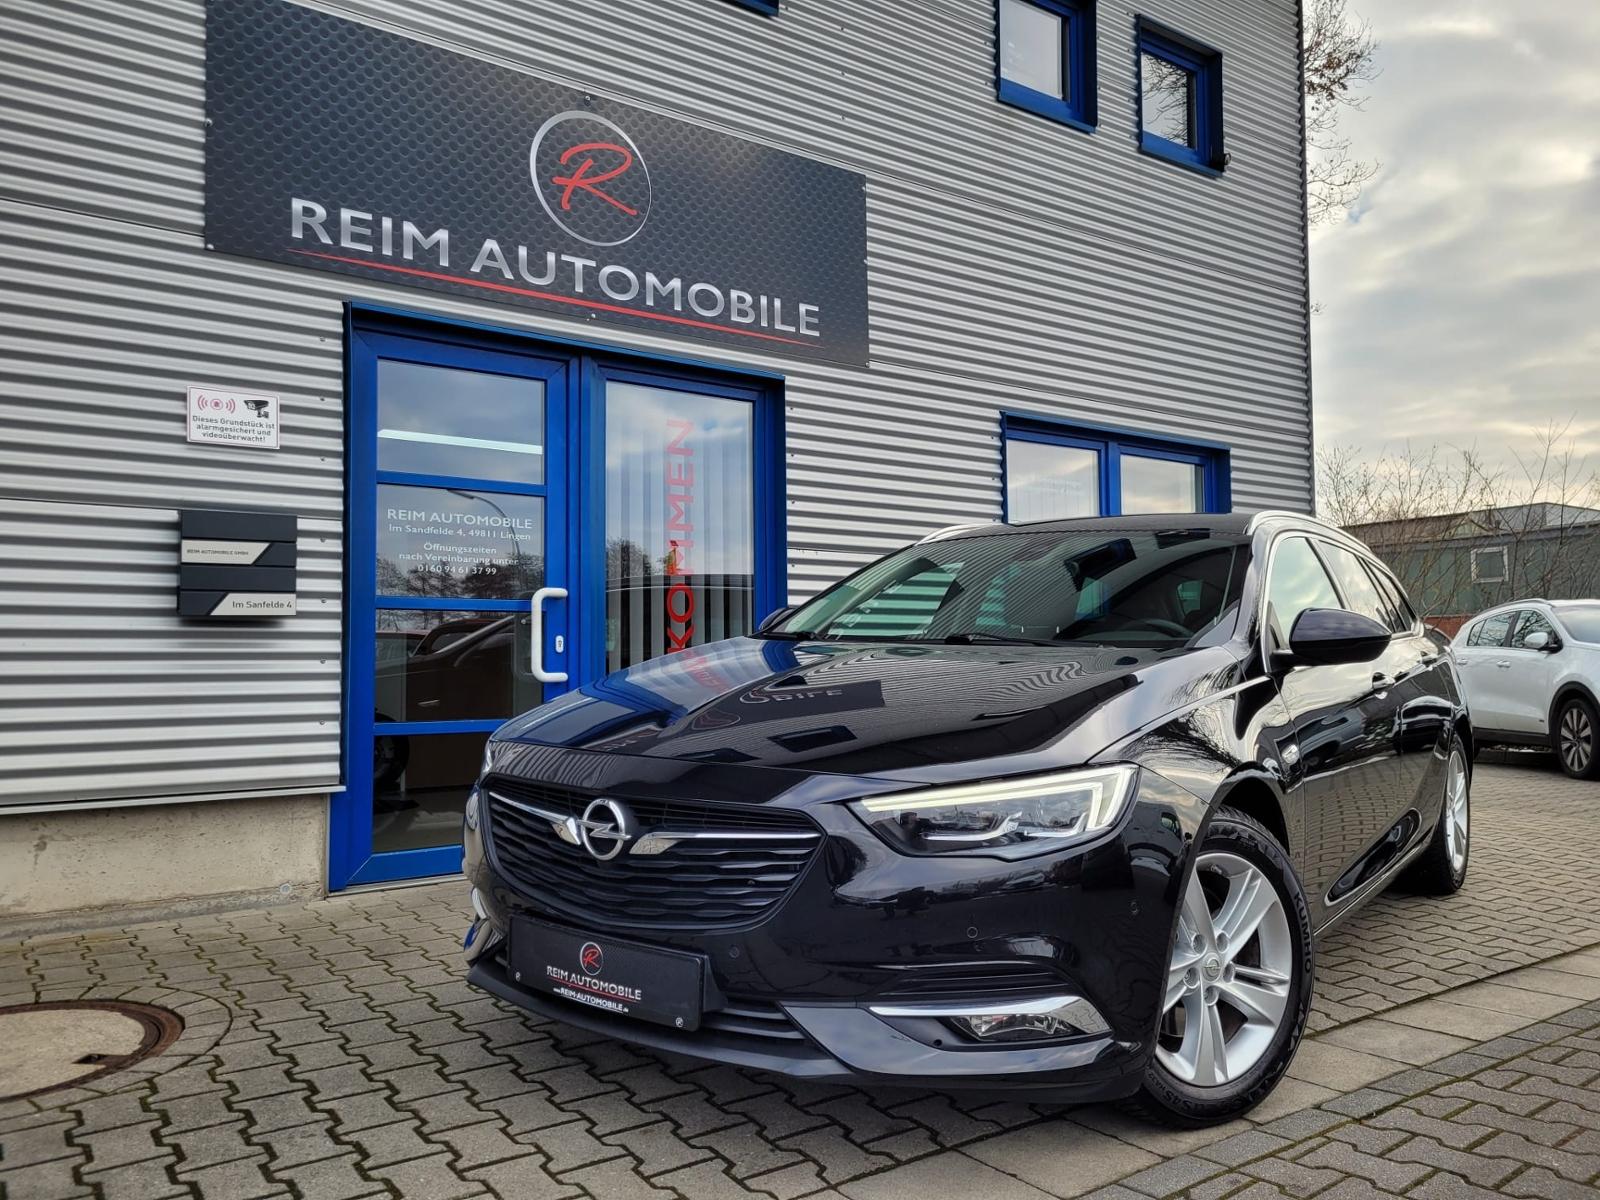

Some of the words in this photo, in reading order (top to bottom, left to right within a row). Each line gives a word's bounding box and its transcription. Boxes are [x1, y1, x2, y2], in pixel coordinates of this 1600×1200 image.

[552, 142, 638, 216] R
[289, 197, 452, 268] REIM
[470, 237, 822, 337] AUTOMOBILE
[192, 415, 218, 424] Dieses
[220, 418, 264, 429] Grundstück
[196, 424, 255, 436] alarmgesichert
[387, 508, 425, 522] REIM
[429, 512, 533, 529] AUTOMOBILE
[389, 523, 402, 532] Im
[404, 525, 454, 536] Sandfelde
[456, 528, 466, 537] 4,
[468, 529, 497, 538] 49811
[500, 530, 531, 541] Lingen
[423, 540, 497, 554] Öffnungszeiten
[399, 552, 423, 561] nach
[424, 553, 491, 566] Vereinbarung
[493, 557, 519, 566] unter
[471, 566, 484, 575] 37
[485, 566, 497, 575] 99
[232, 601, 244, 609] Im
[246, 601, 285, 609] Sanfelde
[286, 601, 292, 609] 4
[1294, 891, 1312, 974] KUMHO
[547, 965, 569, 981] REIM
[569, 973, 642, 1001] AUTOMOBILE
